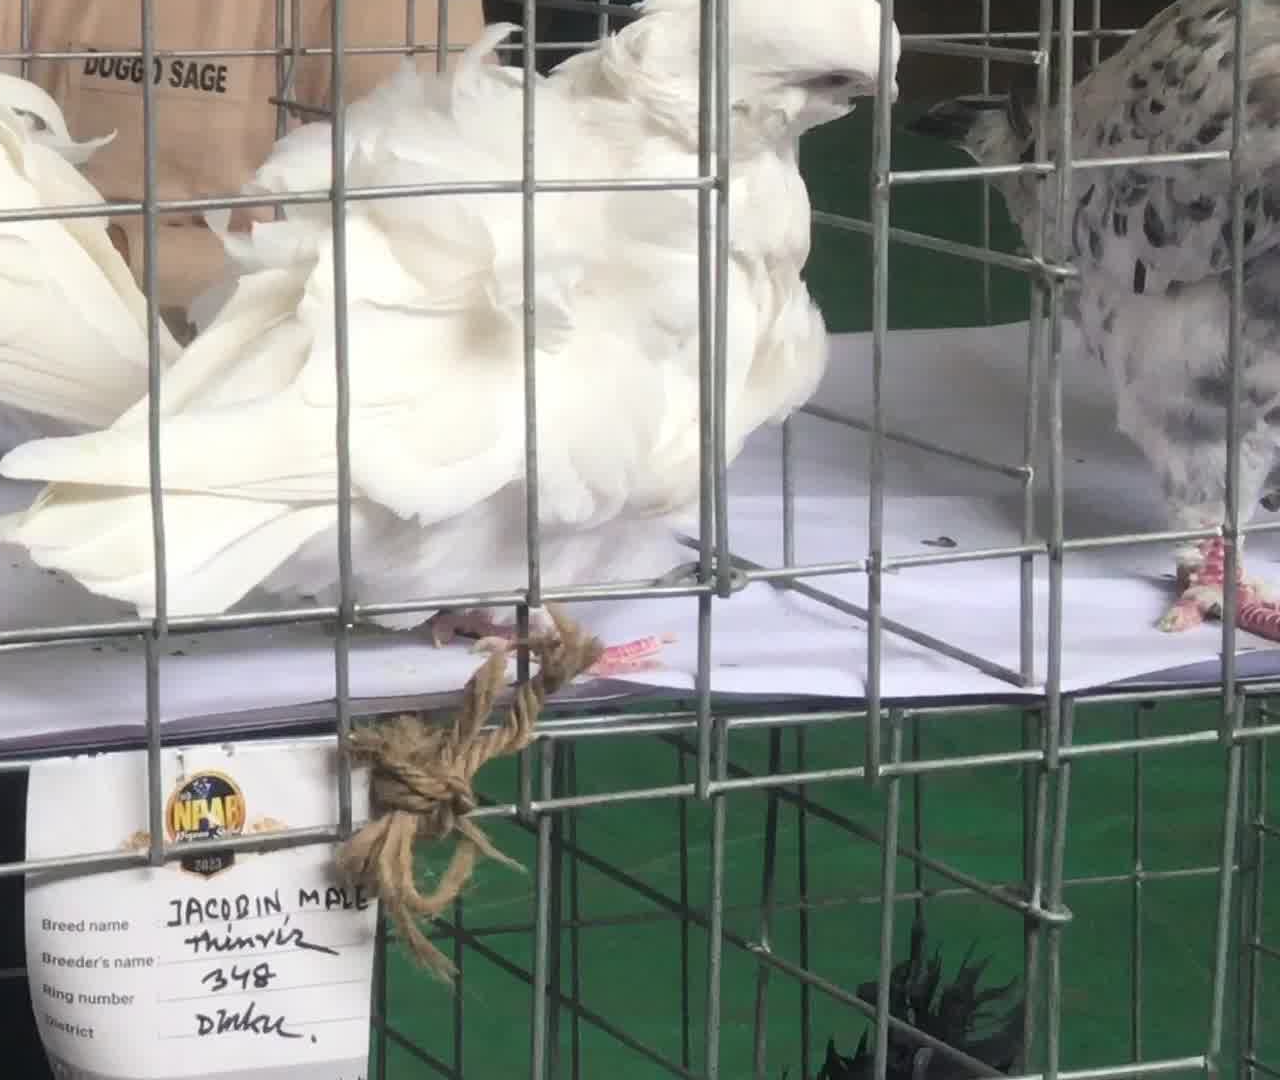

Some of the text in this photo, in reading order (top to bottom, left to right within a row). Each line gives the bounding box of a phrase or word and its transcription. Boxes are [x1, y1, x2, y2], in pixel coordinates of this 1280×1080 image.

[168, 59, 228, 94] SAGE
[166, 886, 369, 927] JACOBIN MALE
[41, 917, 130, 933] Breed name
[41, 951, 155, 969] Breeder's name
[201, 962, 277, 992] 348
[42, 982, 136, 1006] Ring number
[42, 1012, 96, 1040] District
